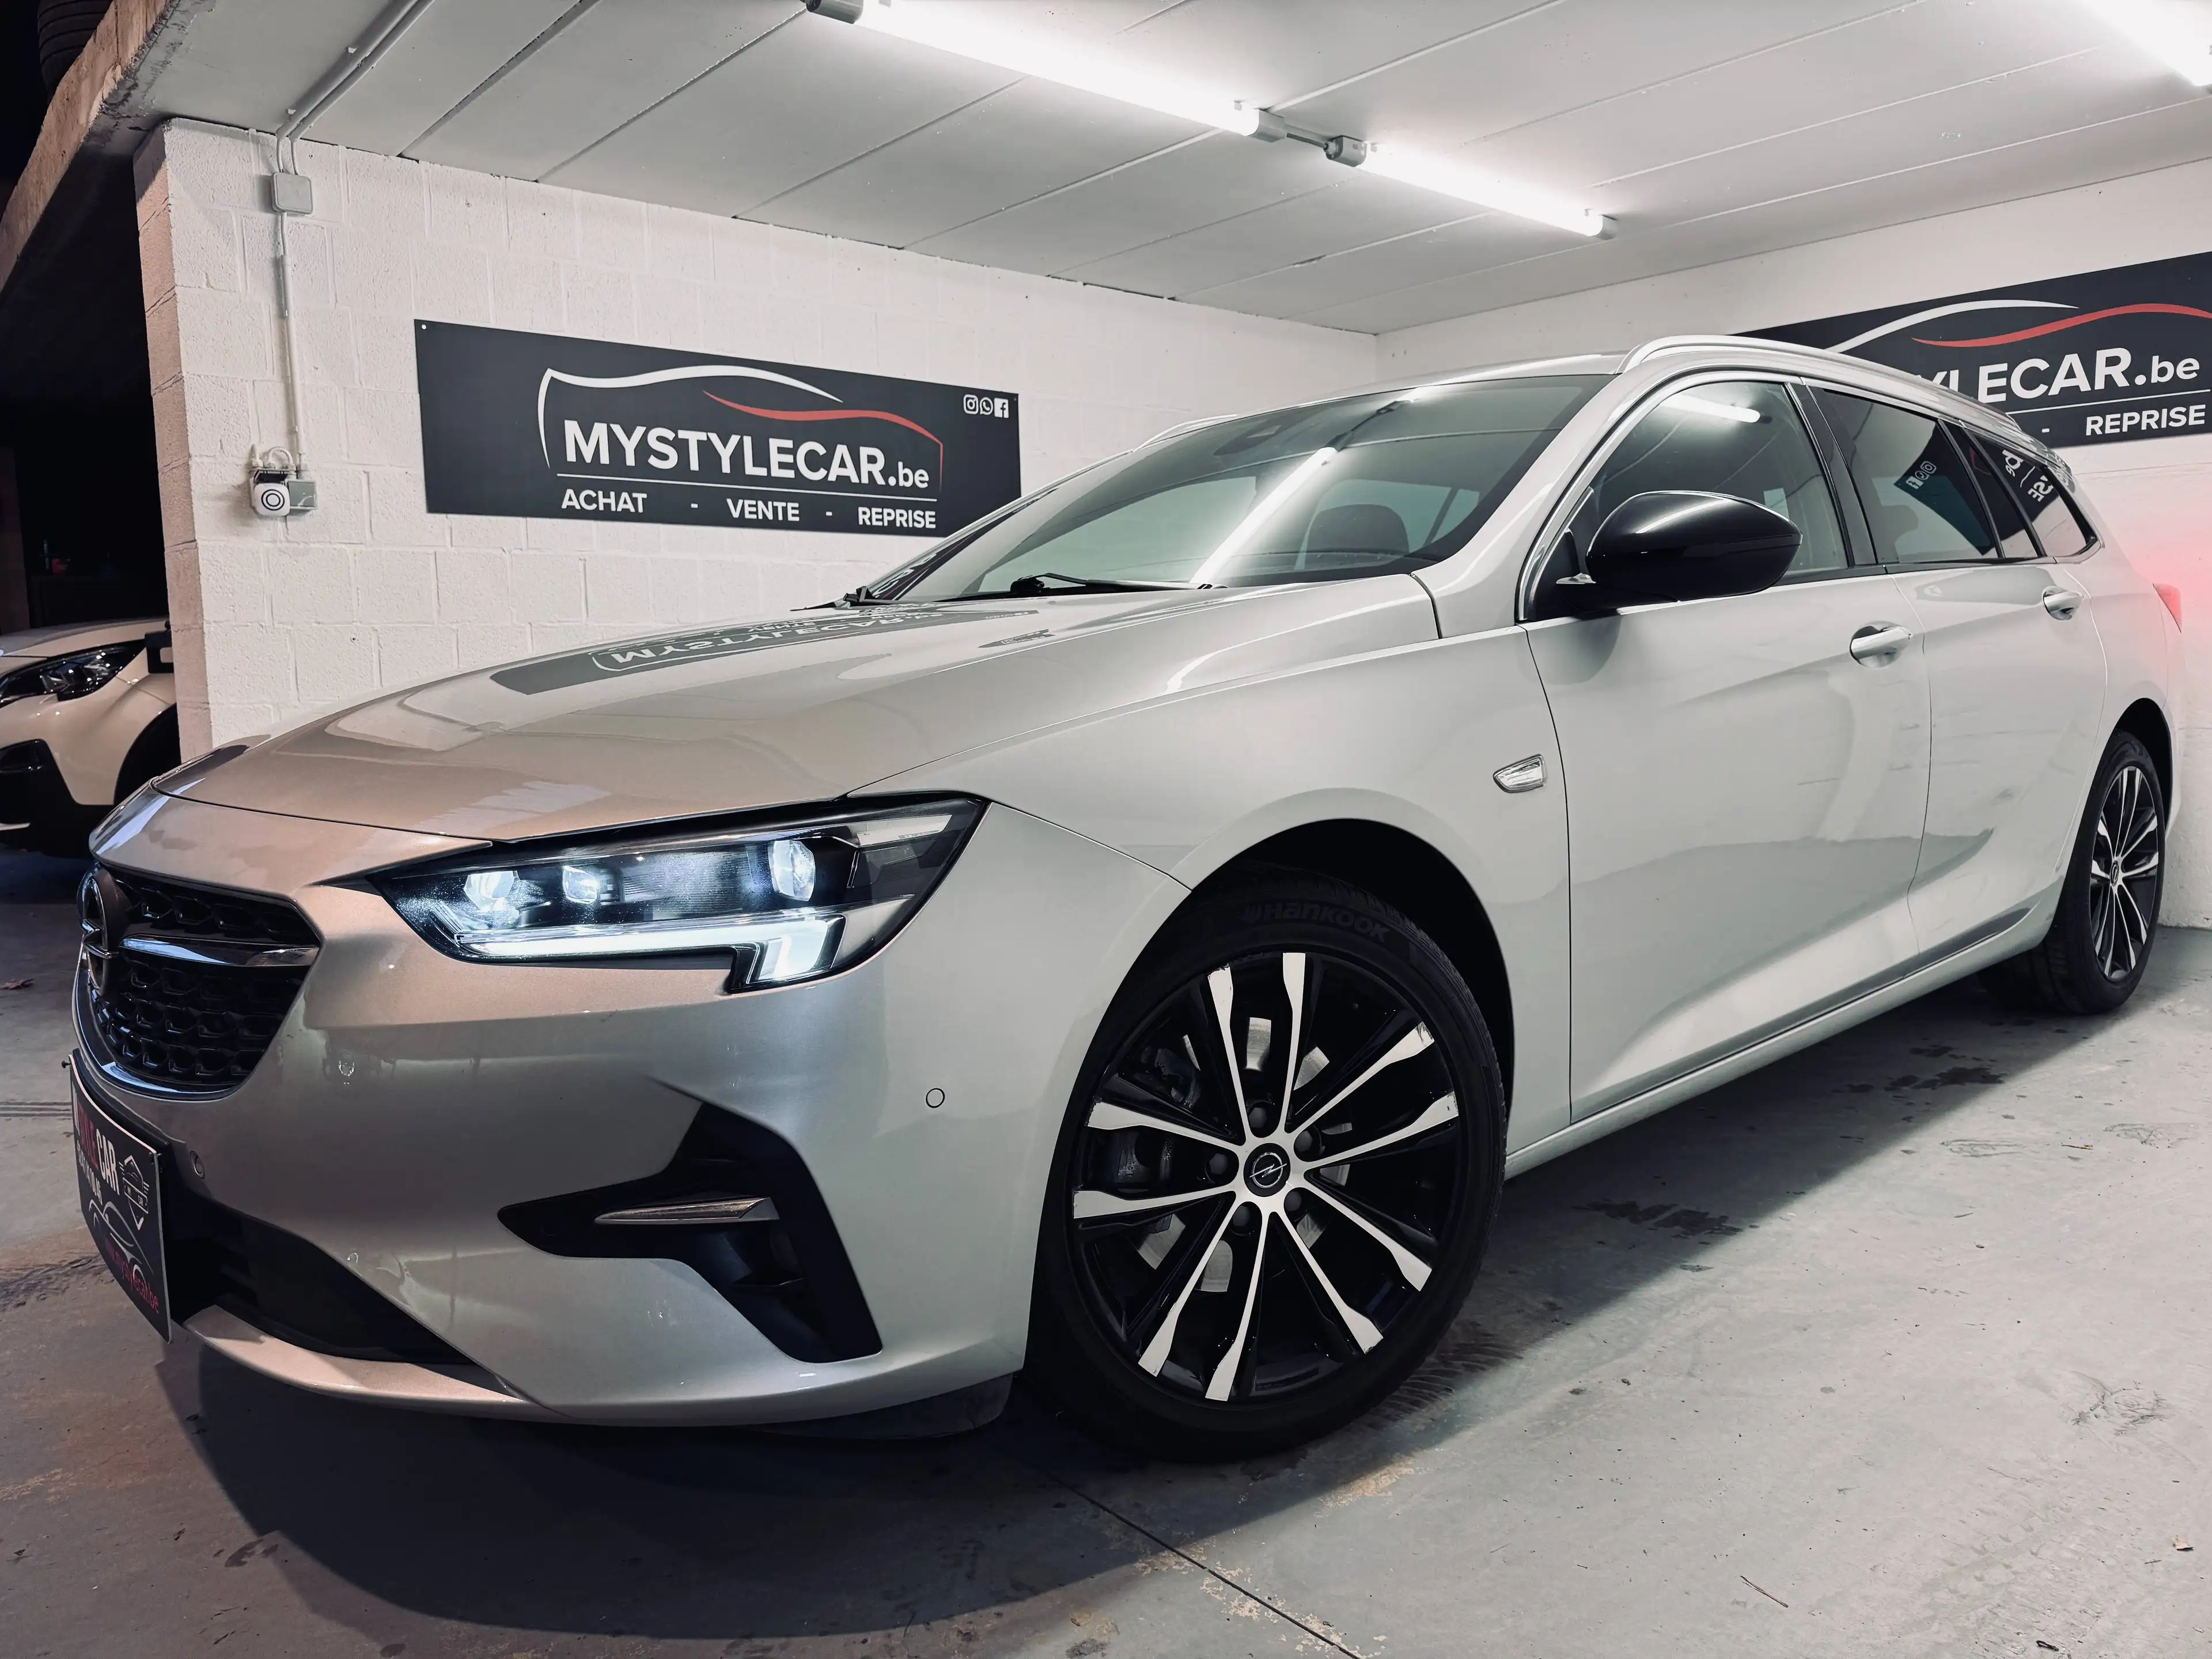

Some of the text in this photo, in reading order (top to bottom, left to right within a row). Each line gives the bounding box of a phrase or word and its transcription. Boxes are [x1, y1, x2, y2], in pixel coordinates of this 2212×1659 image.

[2086, 404, 2206, 436] REPRISE
[564, 419, 930, 489] MYSTYLECAR.be
[561, 488, 648, 513] ACHAT
[726, 498, 800, 522] VENTE
[858, 506, 936, 529] REPRISE
